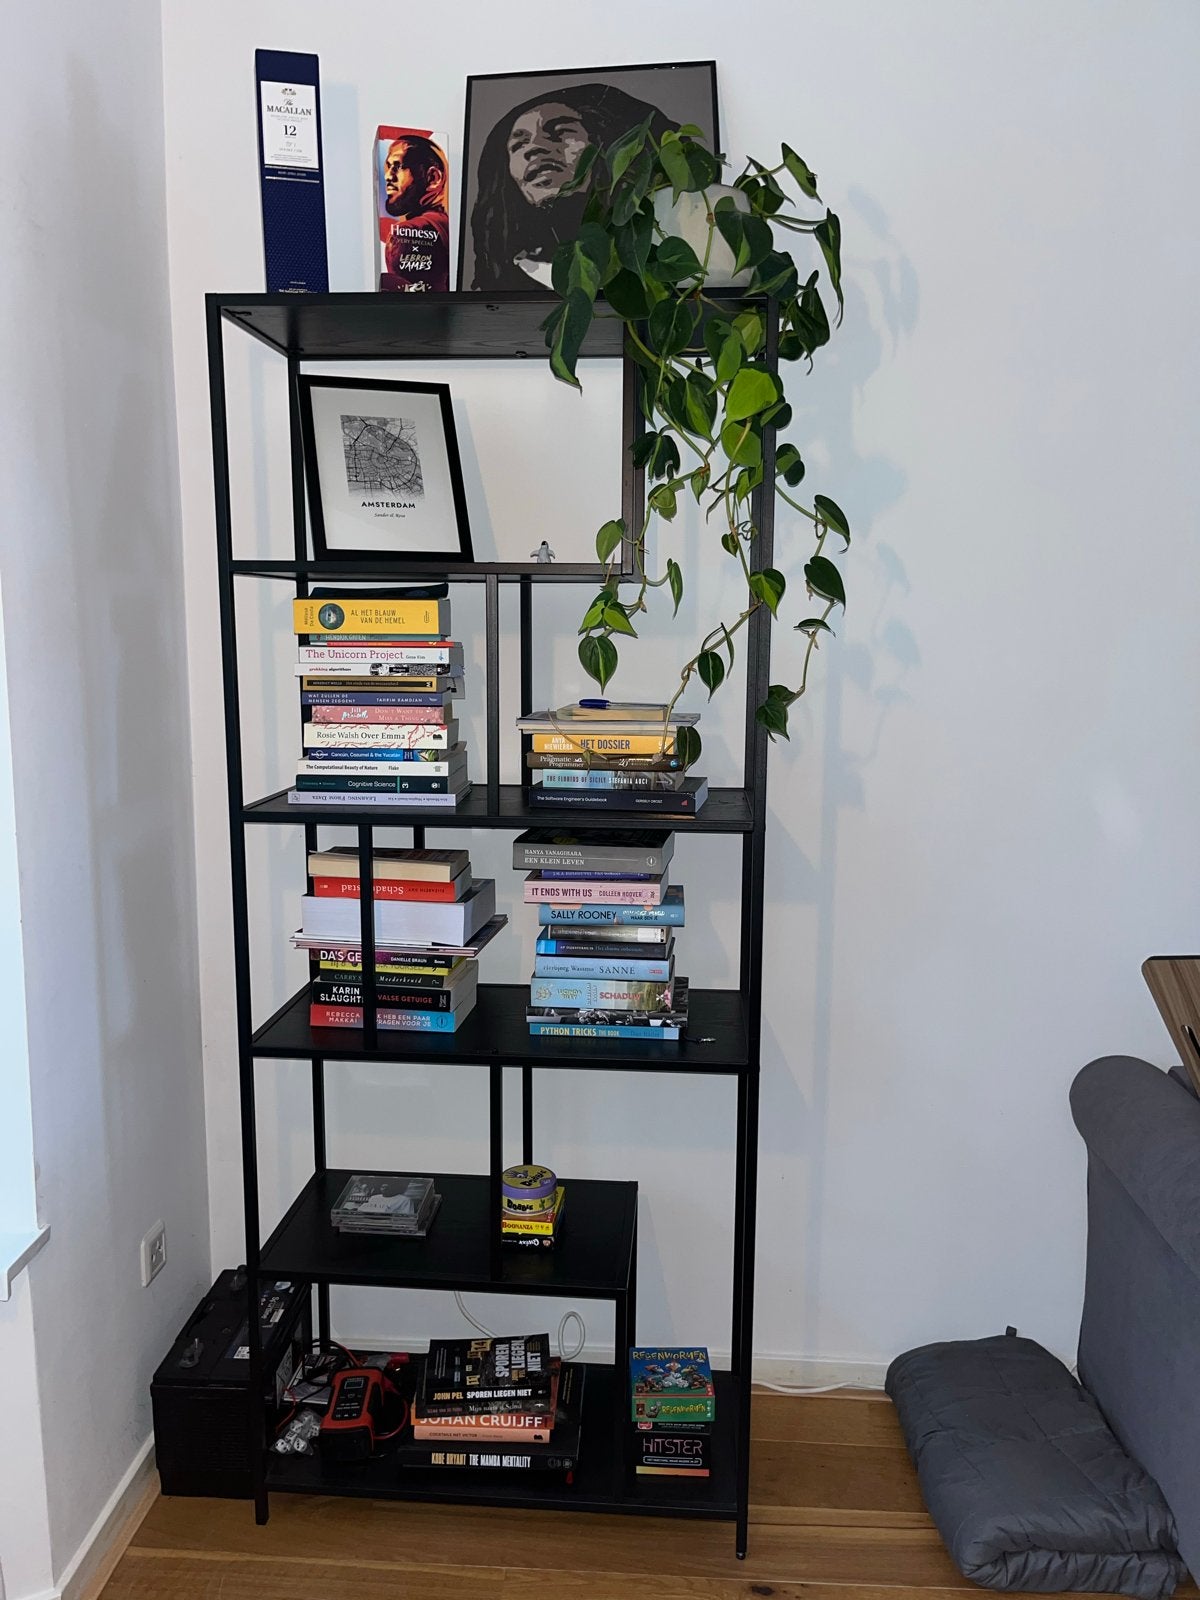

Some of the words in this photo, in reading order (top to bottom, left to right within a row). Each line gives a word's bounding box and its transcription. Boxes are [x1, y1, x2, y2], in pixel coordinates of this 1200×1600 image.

[267, 105, 311, 115] MACALLAN
[284, 125, 296, 136] 12
[391, 224, 439, 242] Hennessy
[400, 261, 432, 271] JAMES
[306, 649, 325, 658] The
[327, 650, 366, 658] Unicorn
[370, 650, 403, 661] Project
[581, 739, 595, 749] HET
[598, 740, 630, 750] DOSSIER
[561, 888, 581, 896] WITH
[551, 911, 575, 919] SALLY
[578, 911, 616, 919] ROONEY
[320, 950, 344, 961] DA'S
[332, 986, 360, 994] KARIN
[320, 994, 364, 1003] SLAUGHT
[600, 992, 640, 1001] SCHADUW
[540, 1027, 569, 1035] PYTHON
[572, 1028, 596, 1036] TRICKS
[507, 1198, 533, 1211] DOBBLE
[511, 1339, 526, 1368] LIEGEN
[632, 1351, 706, 1360] REGENWORMEN
[495, 1343, 510, 1377] SPOREN
[526, 1352, 541, 1372] NIET
[433, 1392, 450, 1400] JOHN
[467, 1390, 492, 1399] SPOREN
[494, 1389, 516, 1398] LIEGEN
[662, 1403, 706, 1413] REGENWORMEN
[420, 1415, 475, 1425] JOHAN
[480, 1415, 542, 1428] CRUIJFF
[643, 1438, 702, 1454] HITSTER
[431, 1452, 445, 1464] KOBE
[446, 1453, 466, 1464] BRYANT
[469, 1454, 479, 1465] THE
[480, 1454, 501, 1466] MAMBA
[502, 1456, 531, 1468] MENTALITY
